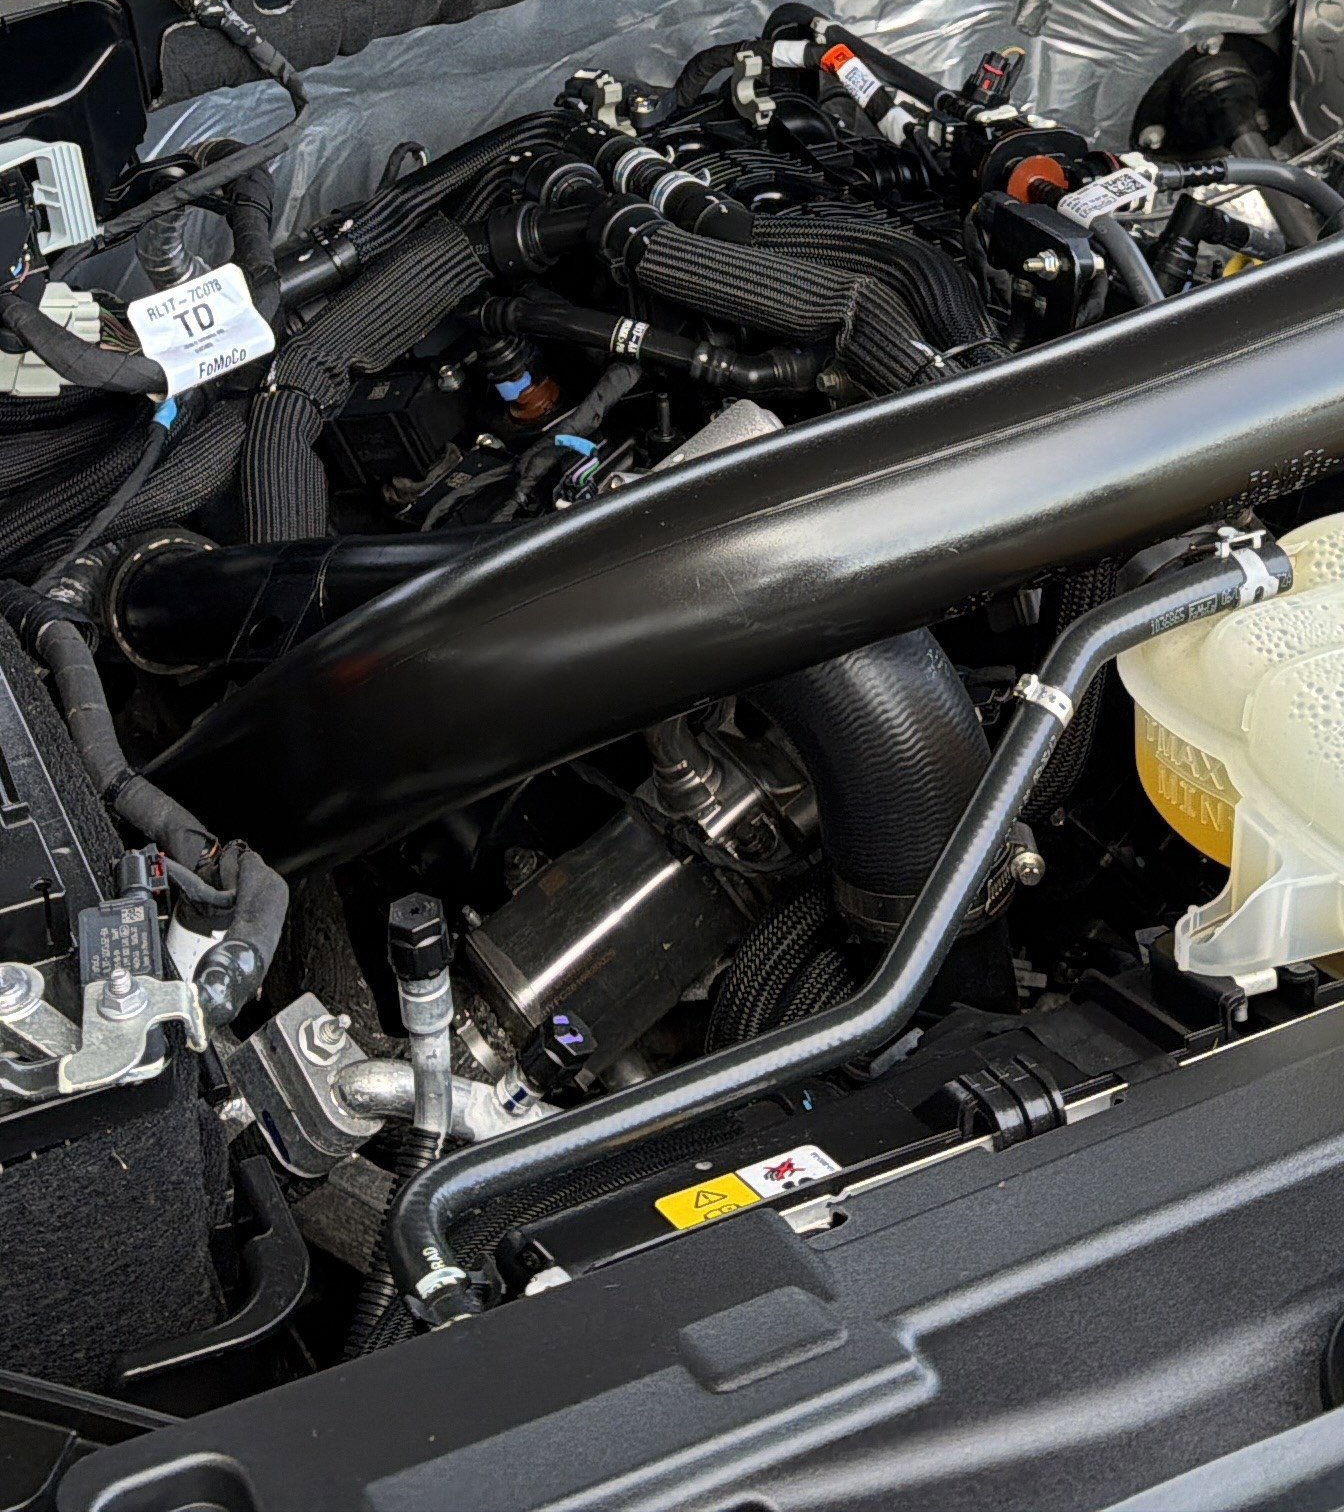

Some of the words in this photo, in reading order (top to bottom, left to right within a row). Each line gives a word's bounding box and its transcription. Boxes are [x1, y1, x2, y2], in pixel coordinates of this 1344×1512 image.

[173, 303, 215, 338] TD
[199, 348, 247, 379] FoMoCo
[1157, 724, 1224, 790] MAX
[1157, 762, 1224, 832] MIN
